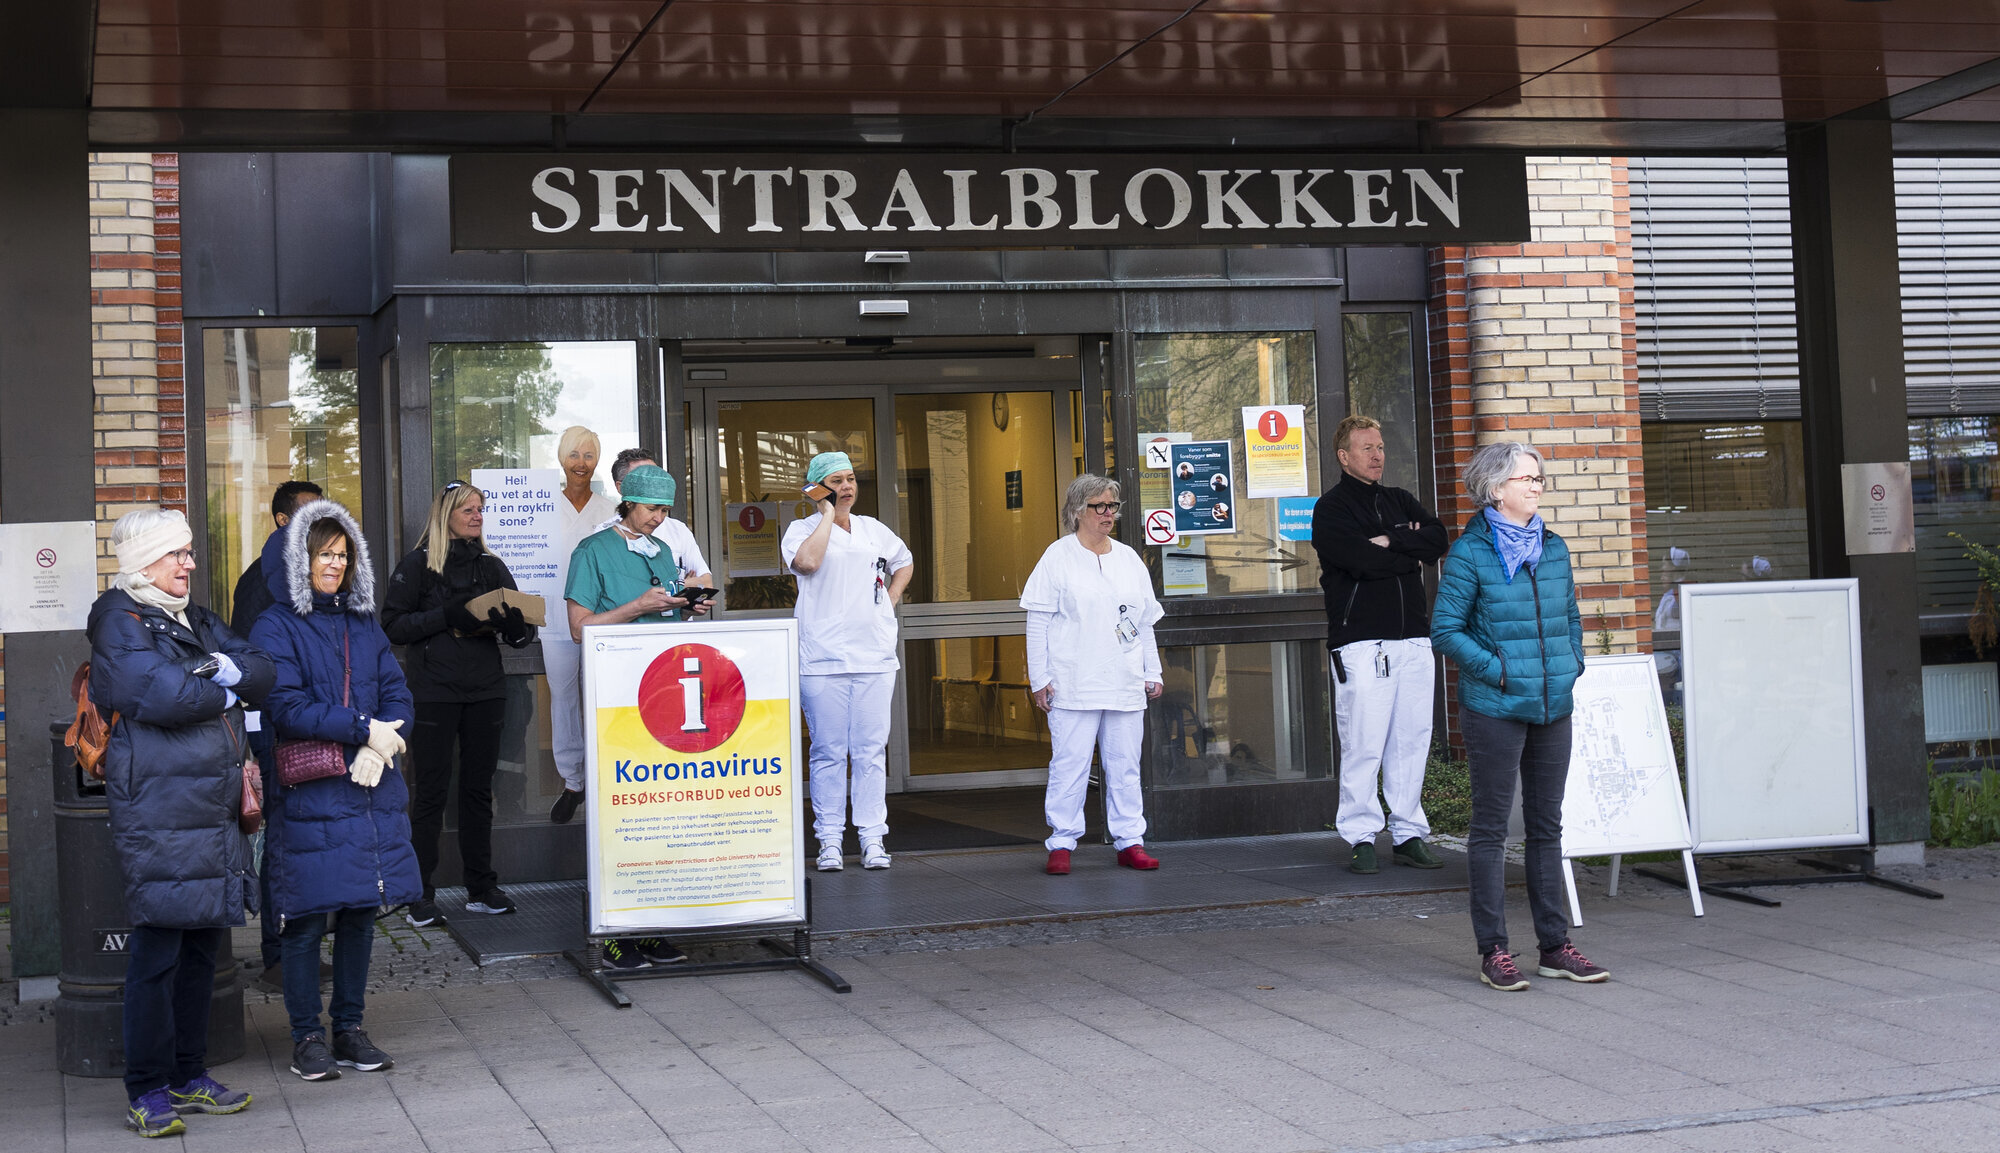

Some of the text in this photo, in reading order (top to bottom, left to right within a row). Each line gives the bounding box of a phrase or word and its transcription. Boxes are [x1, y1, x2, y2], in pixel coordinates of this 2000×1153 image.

[531, 167, 1463, 233] SENTRALBLOKKEN
[1252, 442, 1299, 452] Koronavirus
[505, 476, 527, 485] Hei!
[483, 489, 550, 499] Du vet at du
[494, 503, 496, 512] i
[518, 503, 554, 514] røykfri
[500, 516, 534, 526] sone?
[616, 753, 782, 783] Koronavirus
[612, 784, 782, 806] BESØKSFORBUD ved OUS
